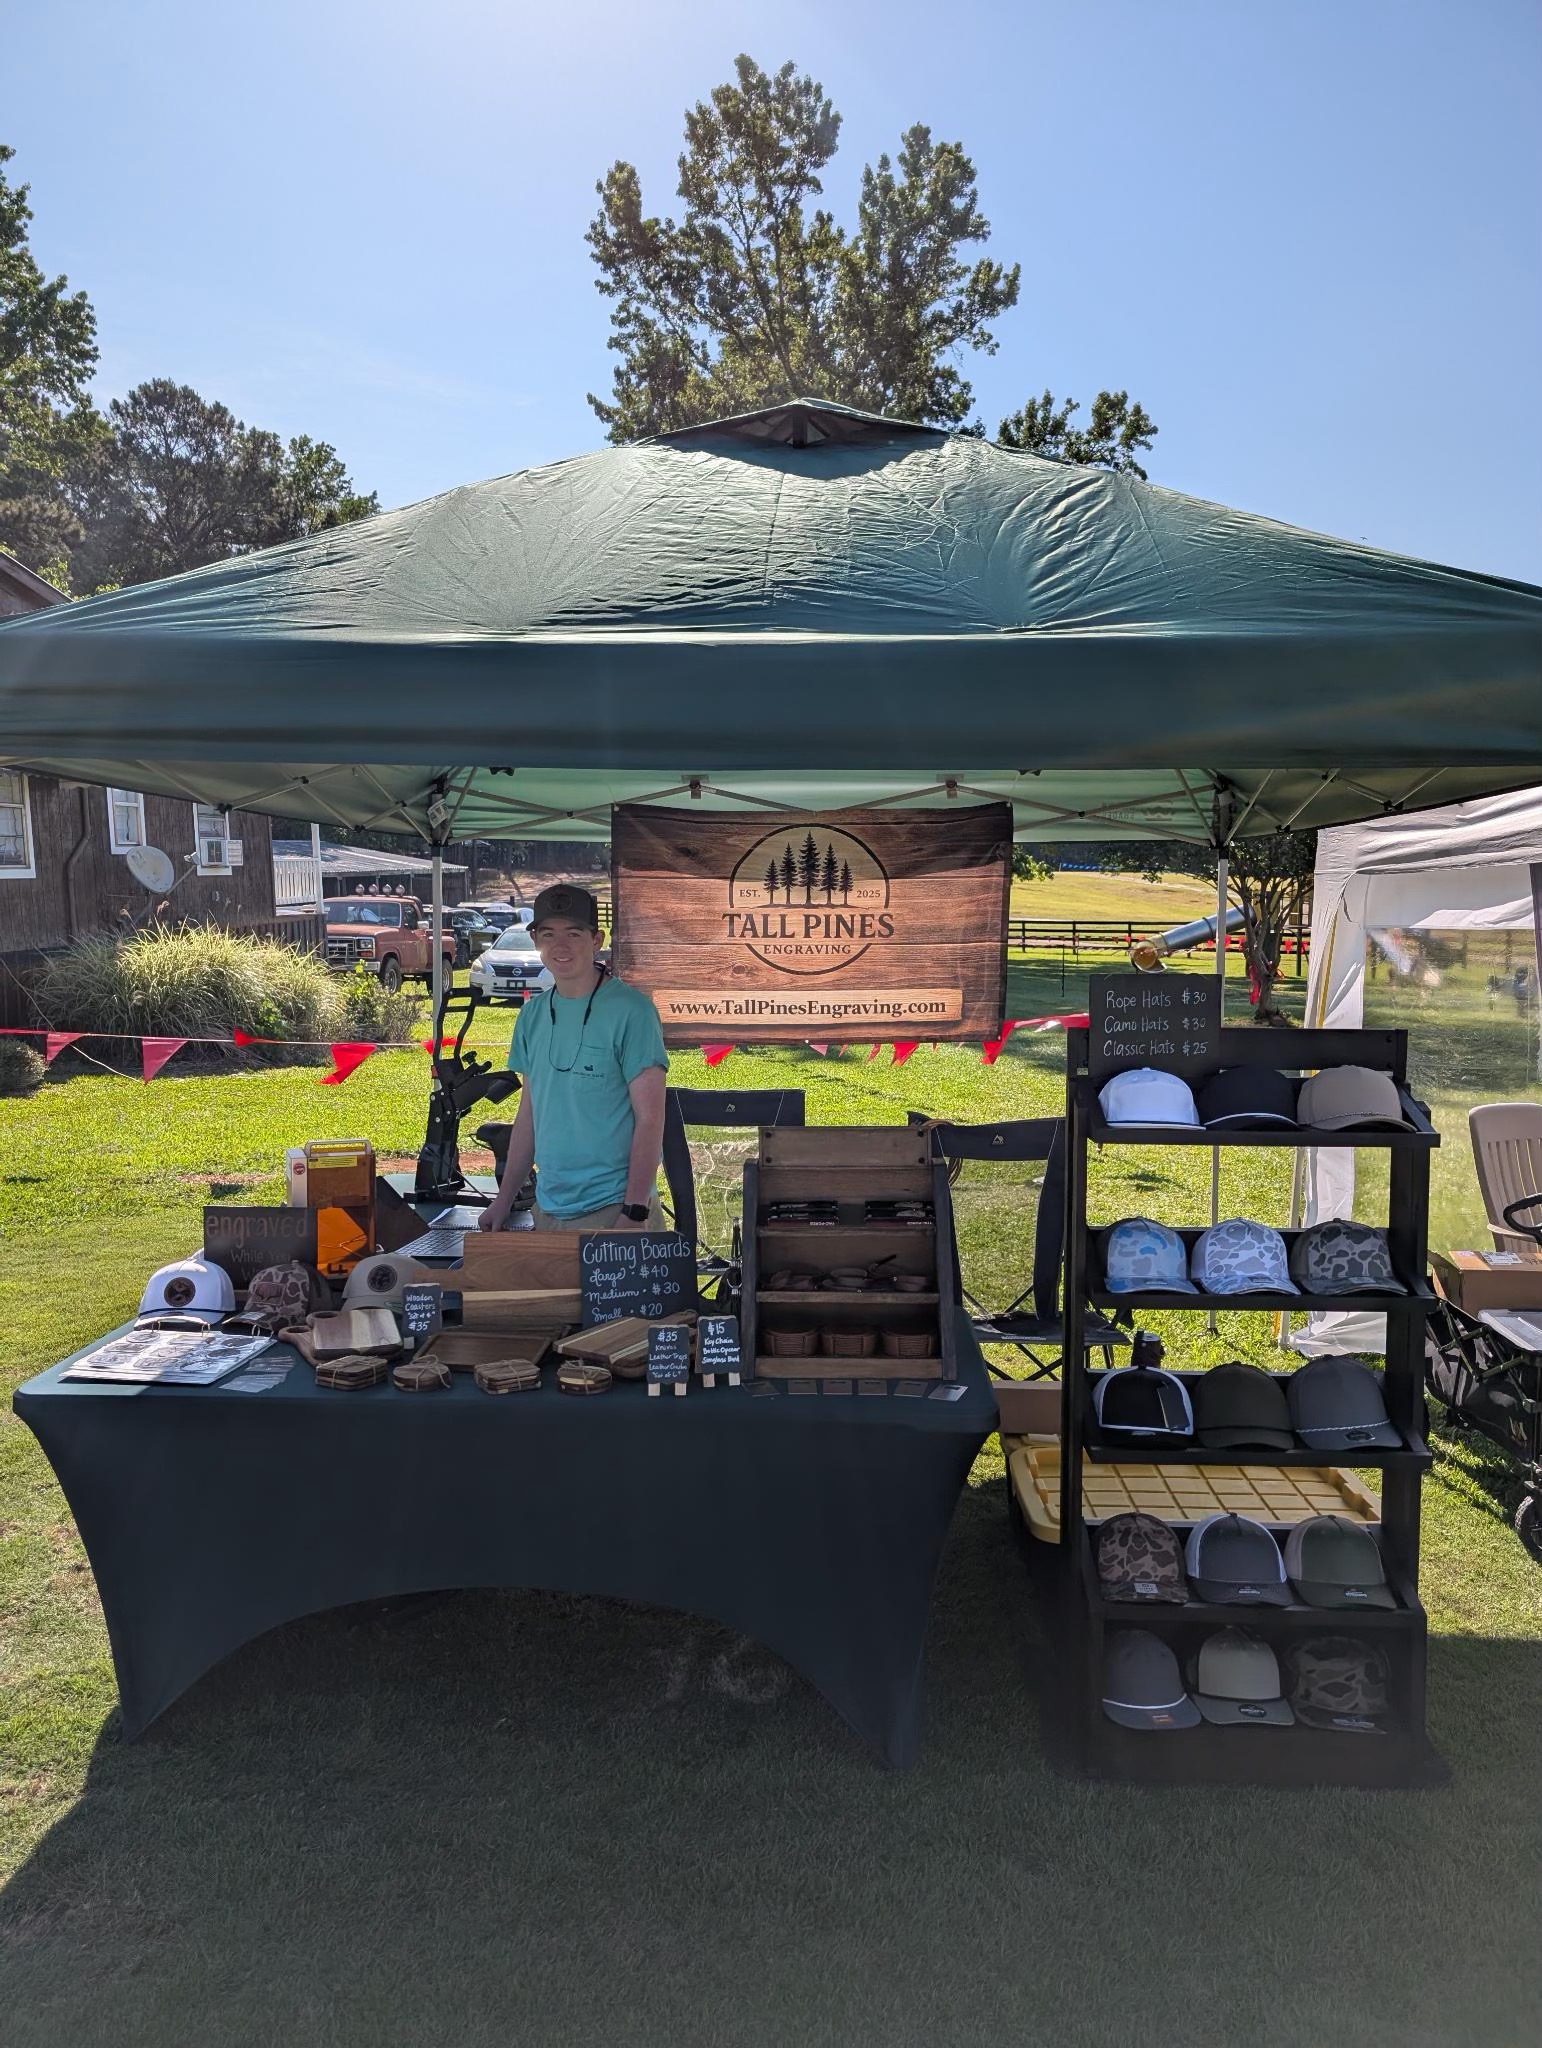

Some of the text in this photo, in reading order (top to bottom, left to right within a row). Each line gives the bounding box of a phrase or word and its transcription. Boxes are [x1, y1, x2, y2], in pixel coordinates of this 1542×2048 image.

[739, 889, 881, 898] EST. 2025
[722, 912, 895, 939] TALL PINES
[763, 944, 852, 955] ENGRAVING
[1106, 987, 1207, 1013] Rope Hats $30
[669, 999, 947, 1018] www.TallPinesEngraving.com
[1104, 1015, 1206, 1034] Camo Hats $30
[1103, 1039, 1209, 1057] Classic Hats $25
[206, 1210, 308, 1249] engraved
[230, 1248, 264, 1263] While
[583, 1236, 691, 1269] Cutting Boards
[589, 1264, 669, 1287] Large $40
[652, 1281, 681, 1296] $30
[406, 1293, 433, 1301] Wooden
[404, 1303, 436, 1311] Coasters
[591, 1303, 663, 1323] Small $20
[408, 1320, 431, 1332] $35
[707, 1321, 726, 1336] $15
[657, 1329, 678, 1342] $35
[715, 1337, 734, 1345] Chain
